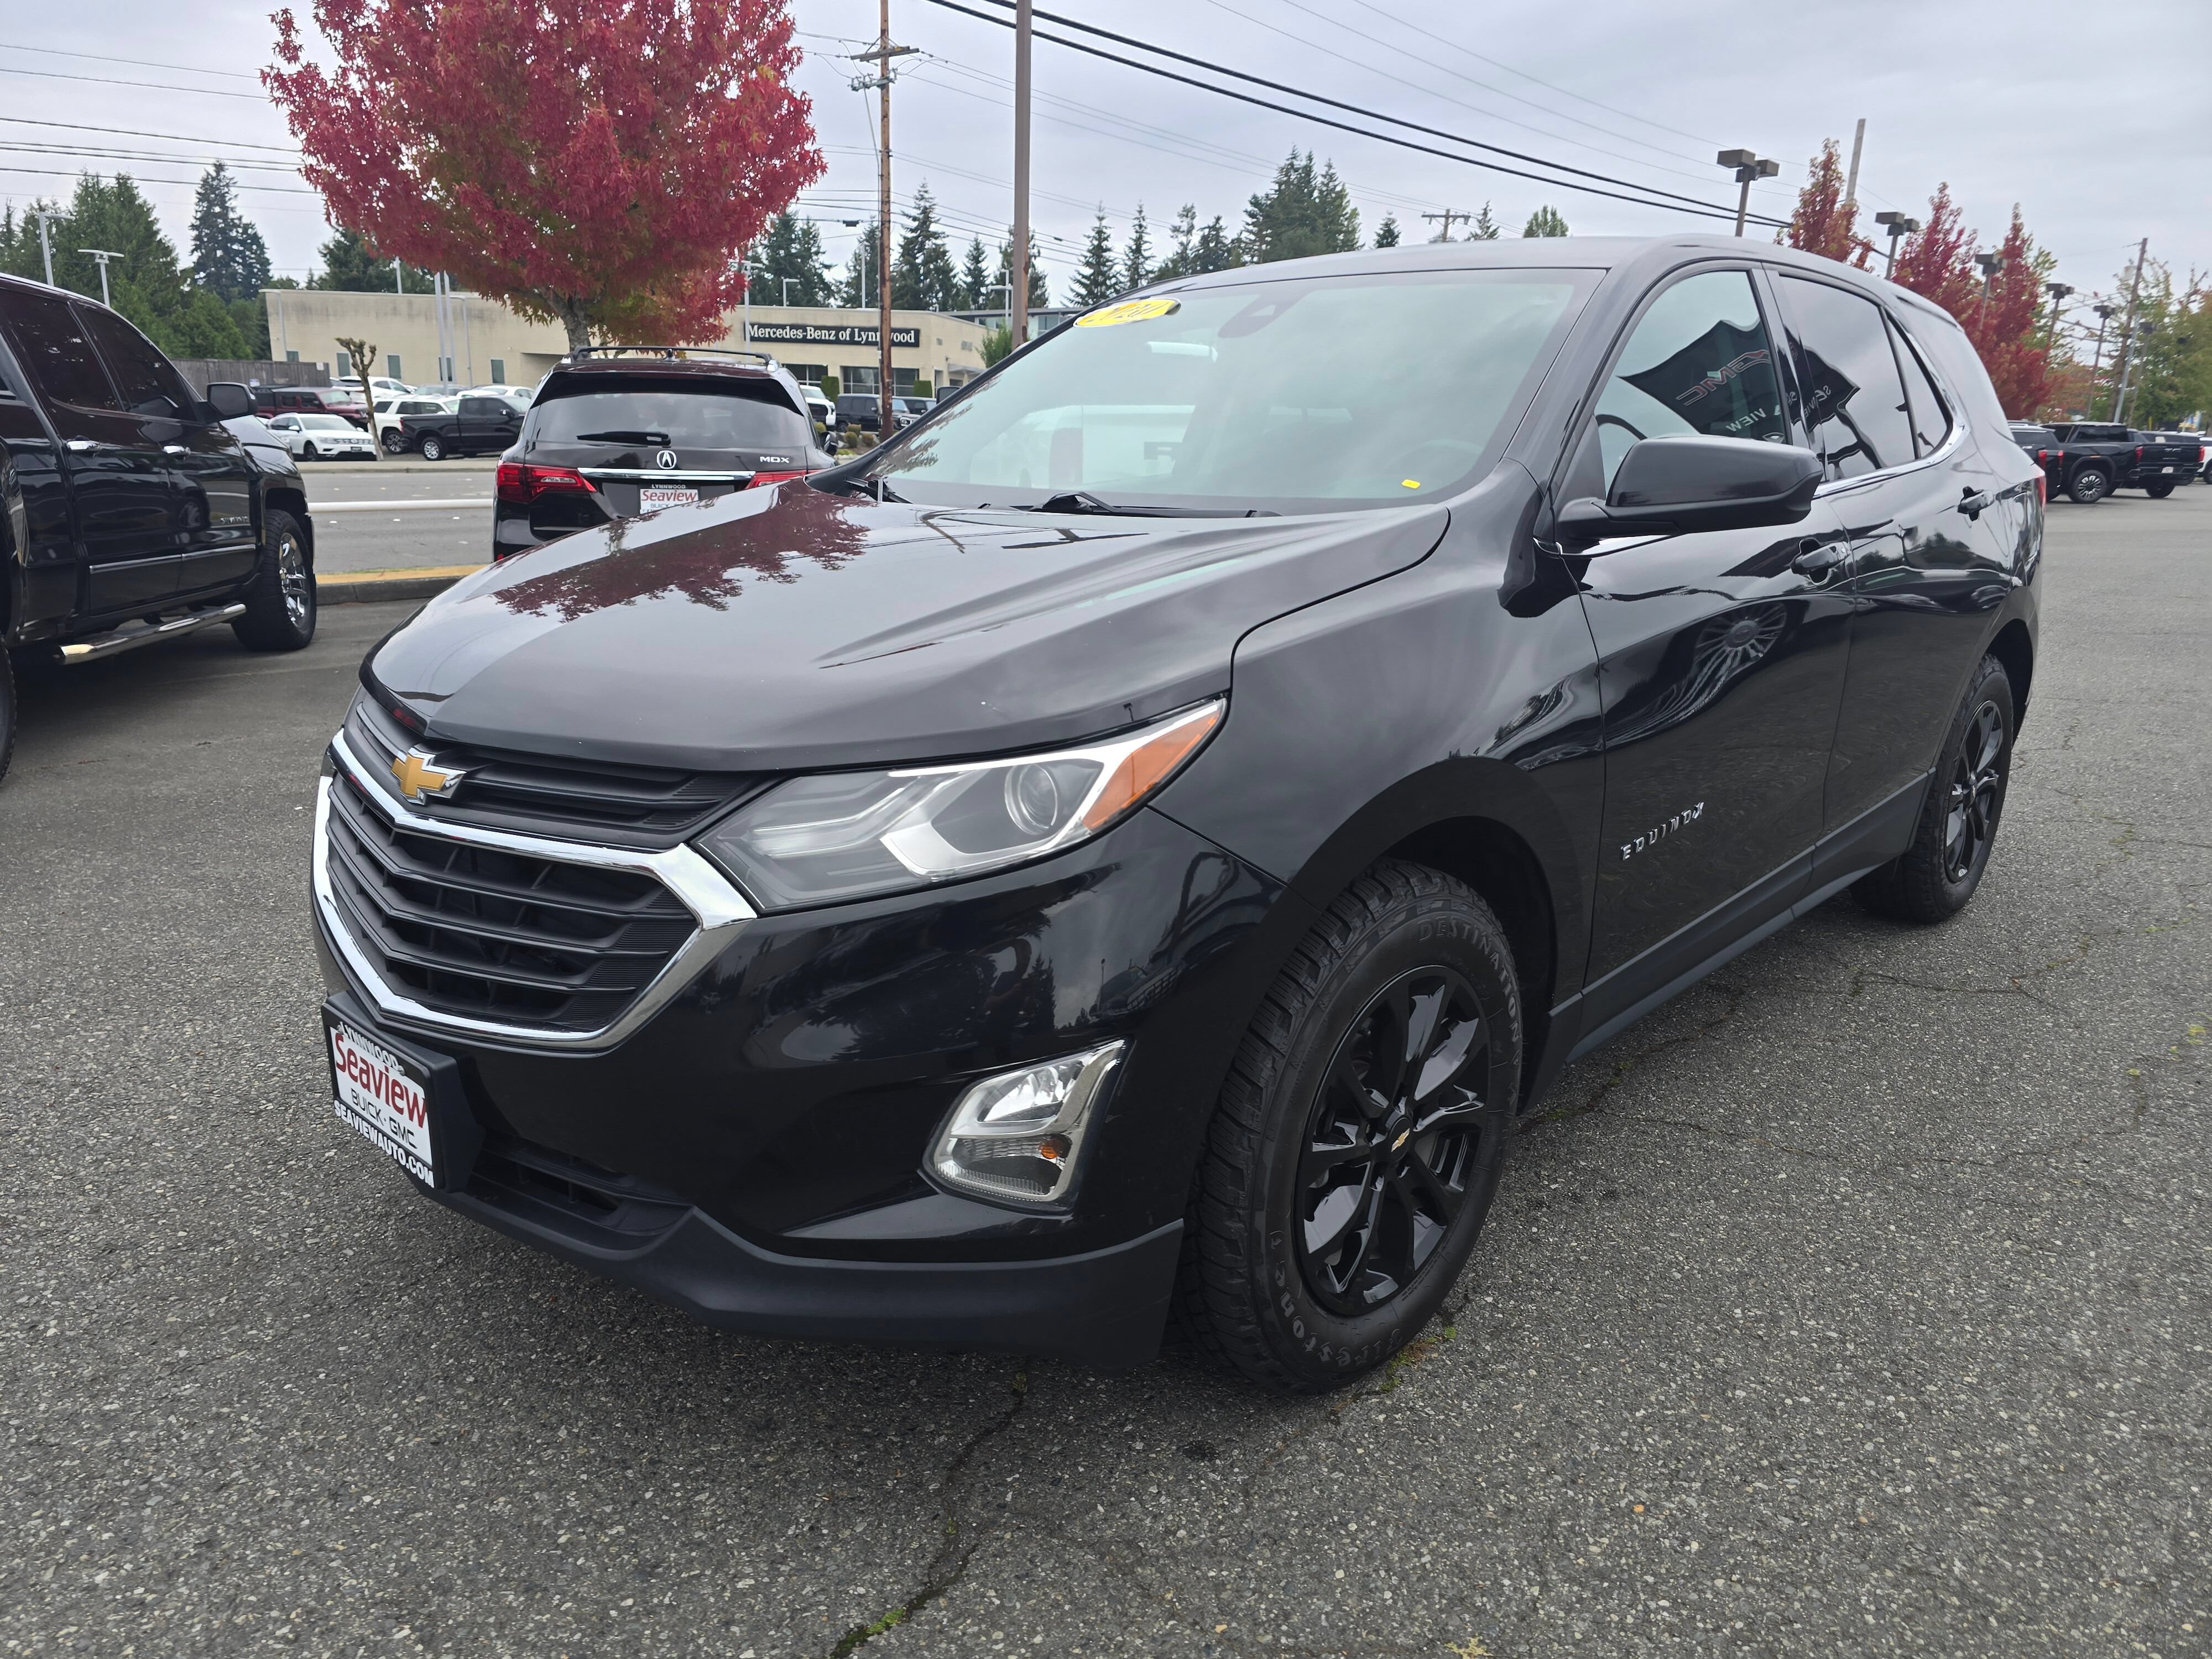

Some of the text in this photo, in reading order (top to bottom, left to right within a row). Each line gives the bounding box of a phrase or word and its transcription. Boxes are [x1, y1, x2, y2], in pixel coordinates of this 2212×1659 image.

[748, 324, 915, 343] Mercedes-Benz of Lynood
[641, 490, 697, 502] Seaview
[1620, 801, 1704, 861] EQUINOX
[1417, 915, 1522, 1043] DESTINATION
[340, 1021, 399, 1068] LYNNWOOD
[335, 1032, 426, 1129] Seaview
[333, 1099, 435, 1188] SEAVIEWAUTO.COM
[351, 1088, 418, 1149] BUICK GMC
[1273, 1260, 1404, 1367] Firestone
